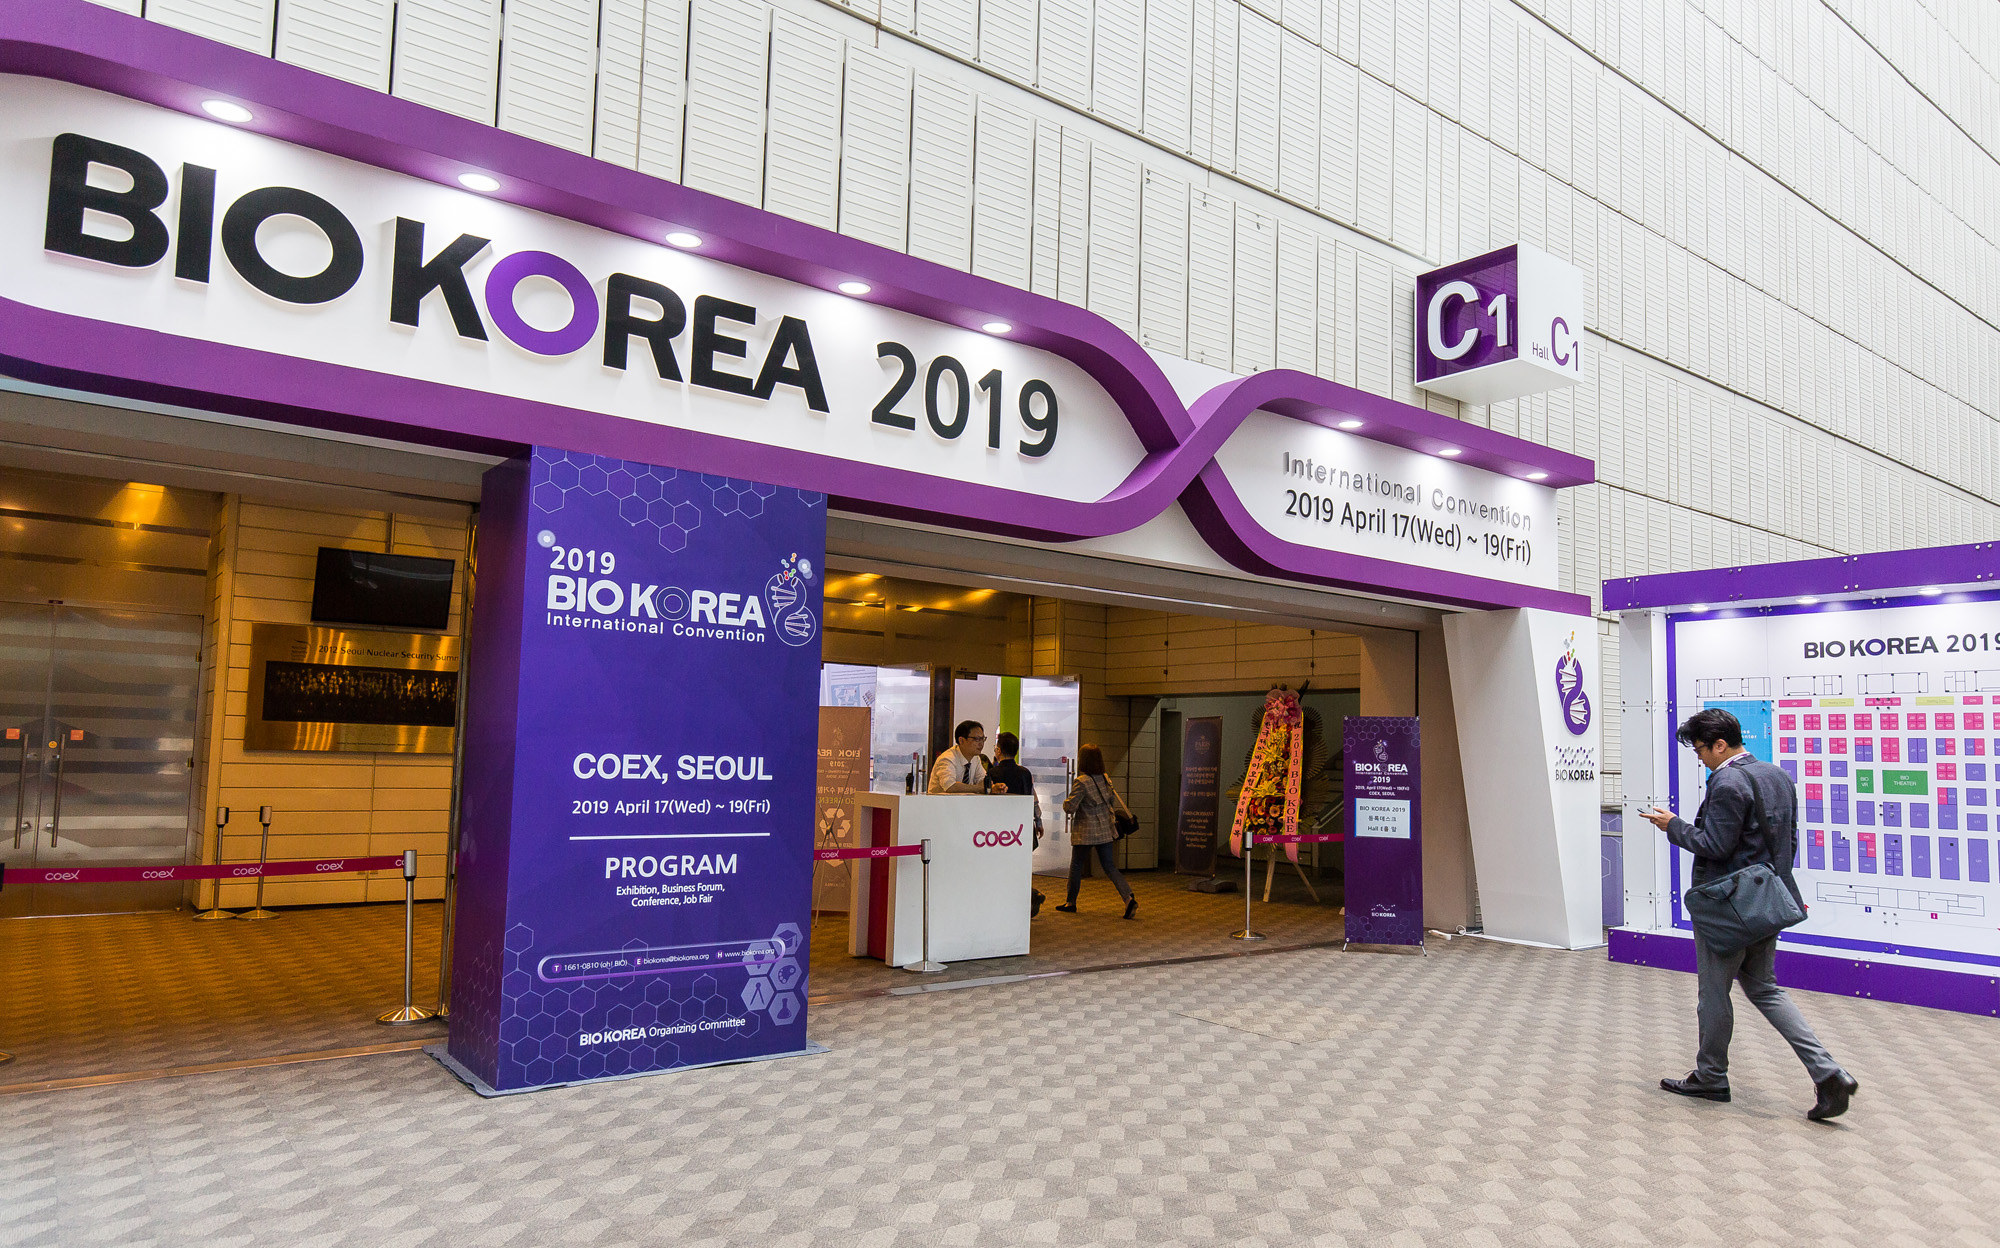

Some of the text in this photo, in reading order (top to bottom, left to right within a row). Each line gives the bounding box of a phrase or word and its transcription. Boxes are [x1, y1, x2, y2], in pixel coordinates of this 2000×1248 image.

[45, 133, 1058, 457] BIO KOREA 2019
[1428, 281, 1508, 360] C1
[1532, 316, 1578, 371] Hall C1
[1283, 452, 1531, 530] International Convention
[1286, 489, 1334, 523] 2019
[1341, 502, 1386, 534] April
[1392, 513, 1462, 551] 17(Wed)
[1484, 533, 1531, 565] 19(Fri)
[550, 546, 616, 574] 2019
[547, 575, 766, 628] BIO KOREA
[547, 612, 765, 643] International Convention
[319, 645, 338, 654] 2012
[341, 647, 364, 656] Seoul
[367, 649, 399, 658] Nuclear
[401, 651, 434, 661] Security
[1804, 640, 1845, 659] BIO
[1850, 636, 1938, 656] KOREA
[573, 753, 772, 784] COEX, SEOUL
[1355, 763, 1372, 772] BIO
[1289, 771, 1299, 795] BIO
[572, 800, 609, 814] 2019
[614, 799, 650, 816] April
[655, 799, 711, 815] 17(Wed)
[729, 799, 770, 815] 19(Fri)
[1286, 800, 1296, 835] KORE
[973, 824, 1023, 848] coex
[821, 850, 839, 858] coex
[871, 848, 888, 856] coex
[45, 870, 80, 881] coex
[143, 868, 175, 879] coex
[233, 864, 263, 876] coex
[316, 860, 344, 872] coex
[605, 854, 738, 879] PROGRAM
[616, 882, 725, 896] Exhibition, Business Forum,
[631, 894, 713, 907] Conference, Job Fair
[564, 962, 600, 971] 1661-0810
[644, 953, 709, 965] biokorea@biokorea.org
[725, 949, 774, 957] www.biokorea.org
[579, 1017, 746, 1046] BIO KOREA Organizing Committee
